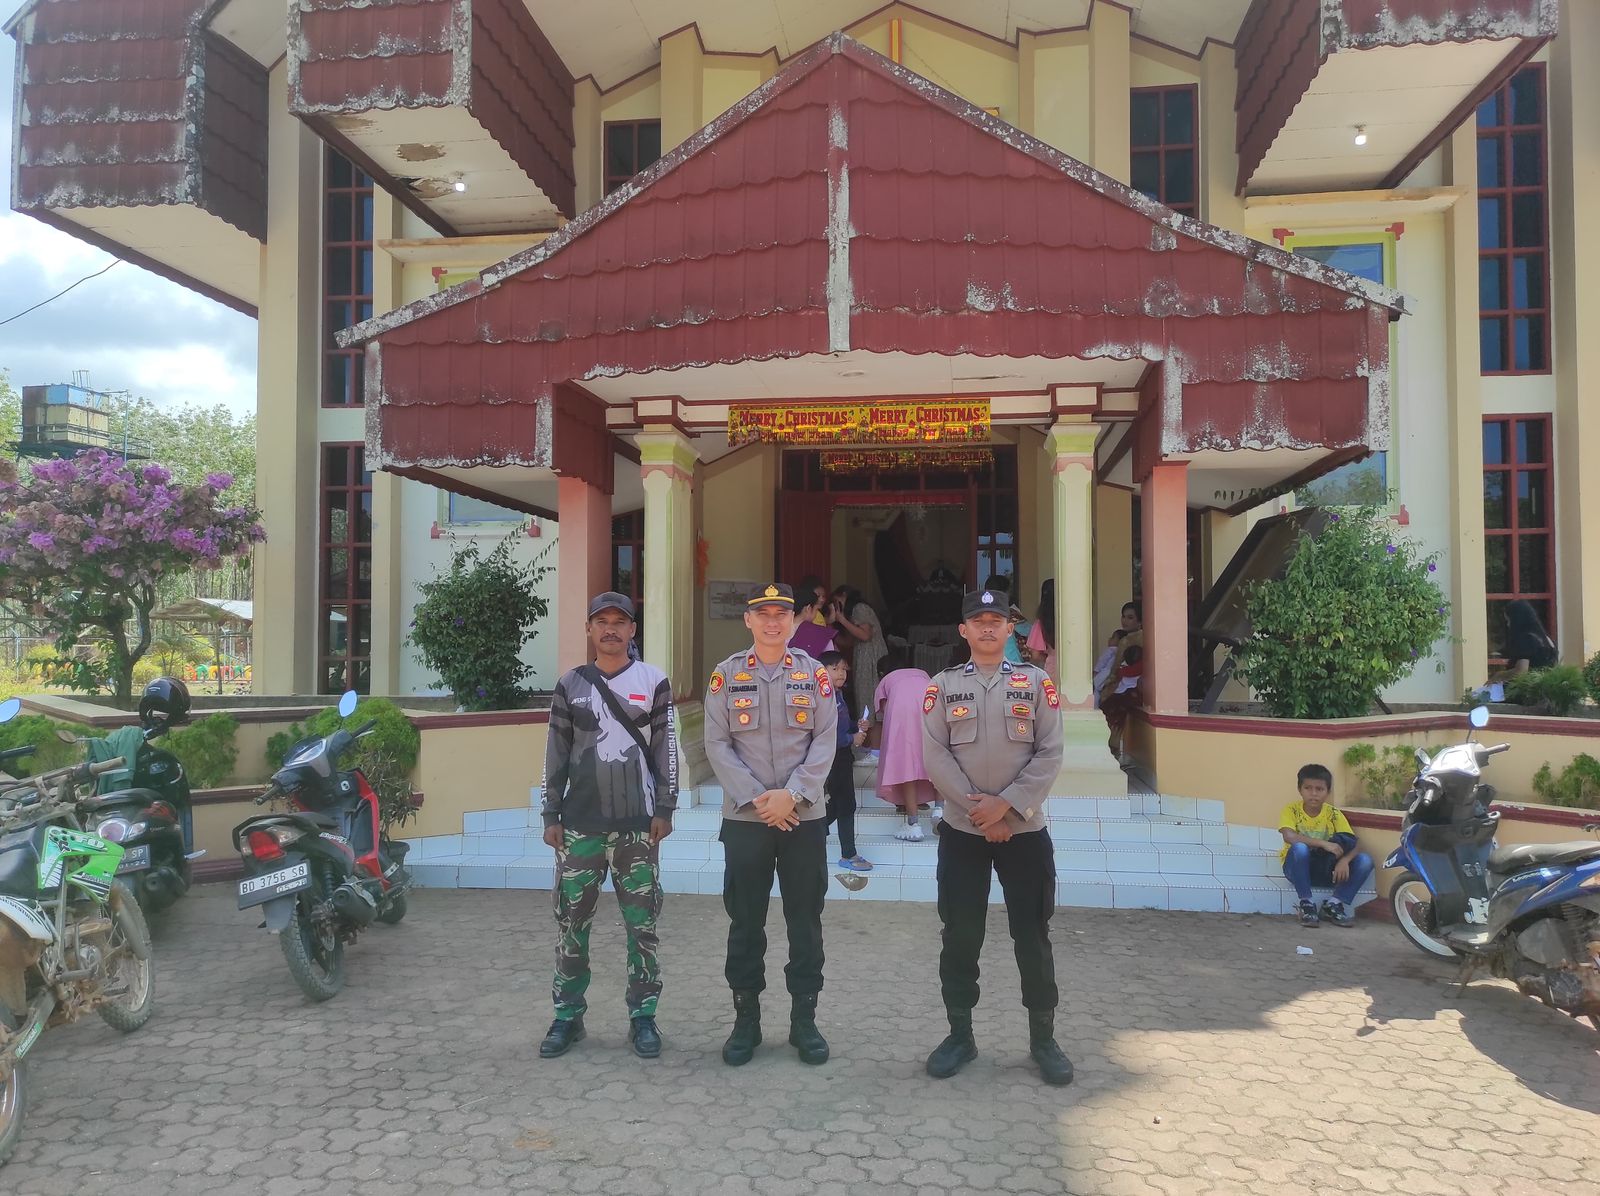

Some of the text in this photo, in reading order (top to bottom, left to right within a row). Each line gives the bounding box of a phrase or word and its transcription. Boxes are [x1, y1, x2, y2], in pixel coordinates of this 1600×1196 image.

[785, 410, 848, 427] CHRISTMAS
[869, 407, 908, 424] MERRY
[915, 406, 981, 423] CHRISTMAS
[786, 683, 814, 691] POLRI
[946, 692, 975, 704] DIMAS
[1006, 691, 1034, 701] POLRI
[242, 881, 255, 894] BD
[260, 872, 286, 888] 3756
